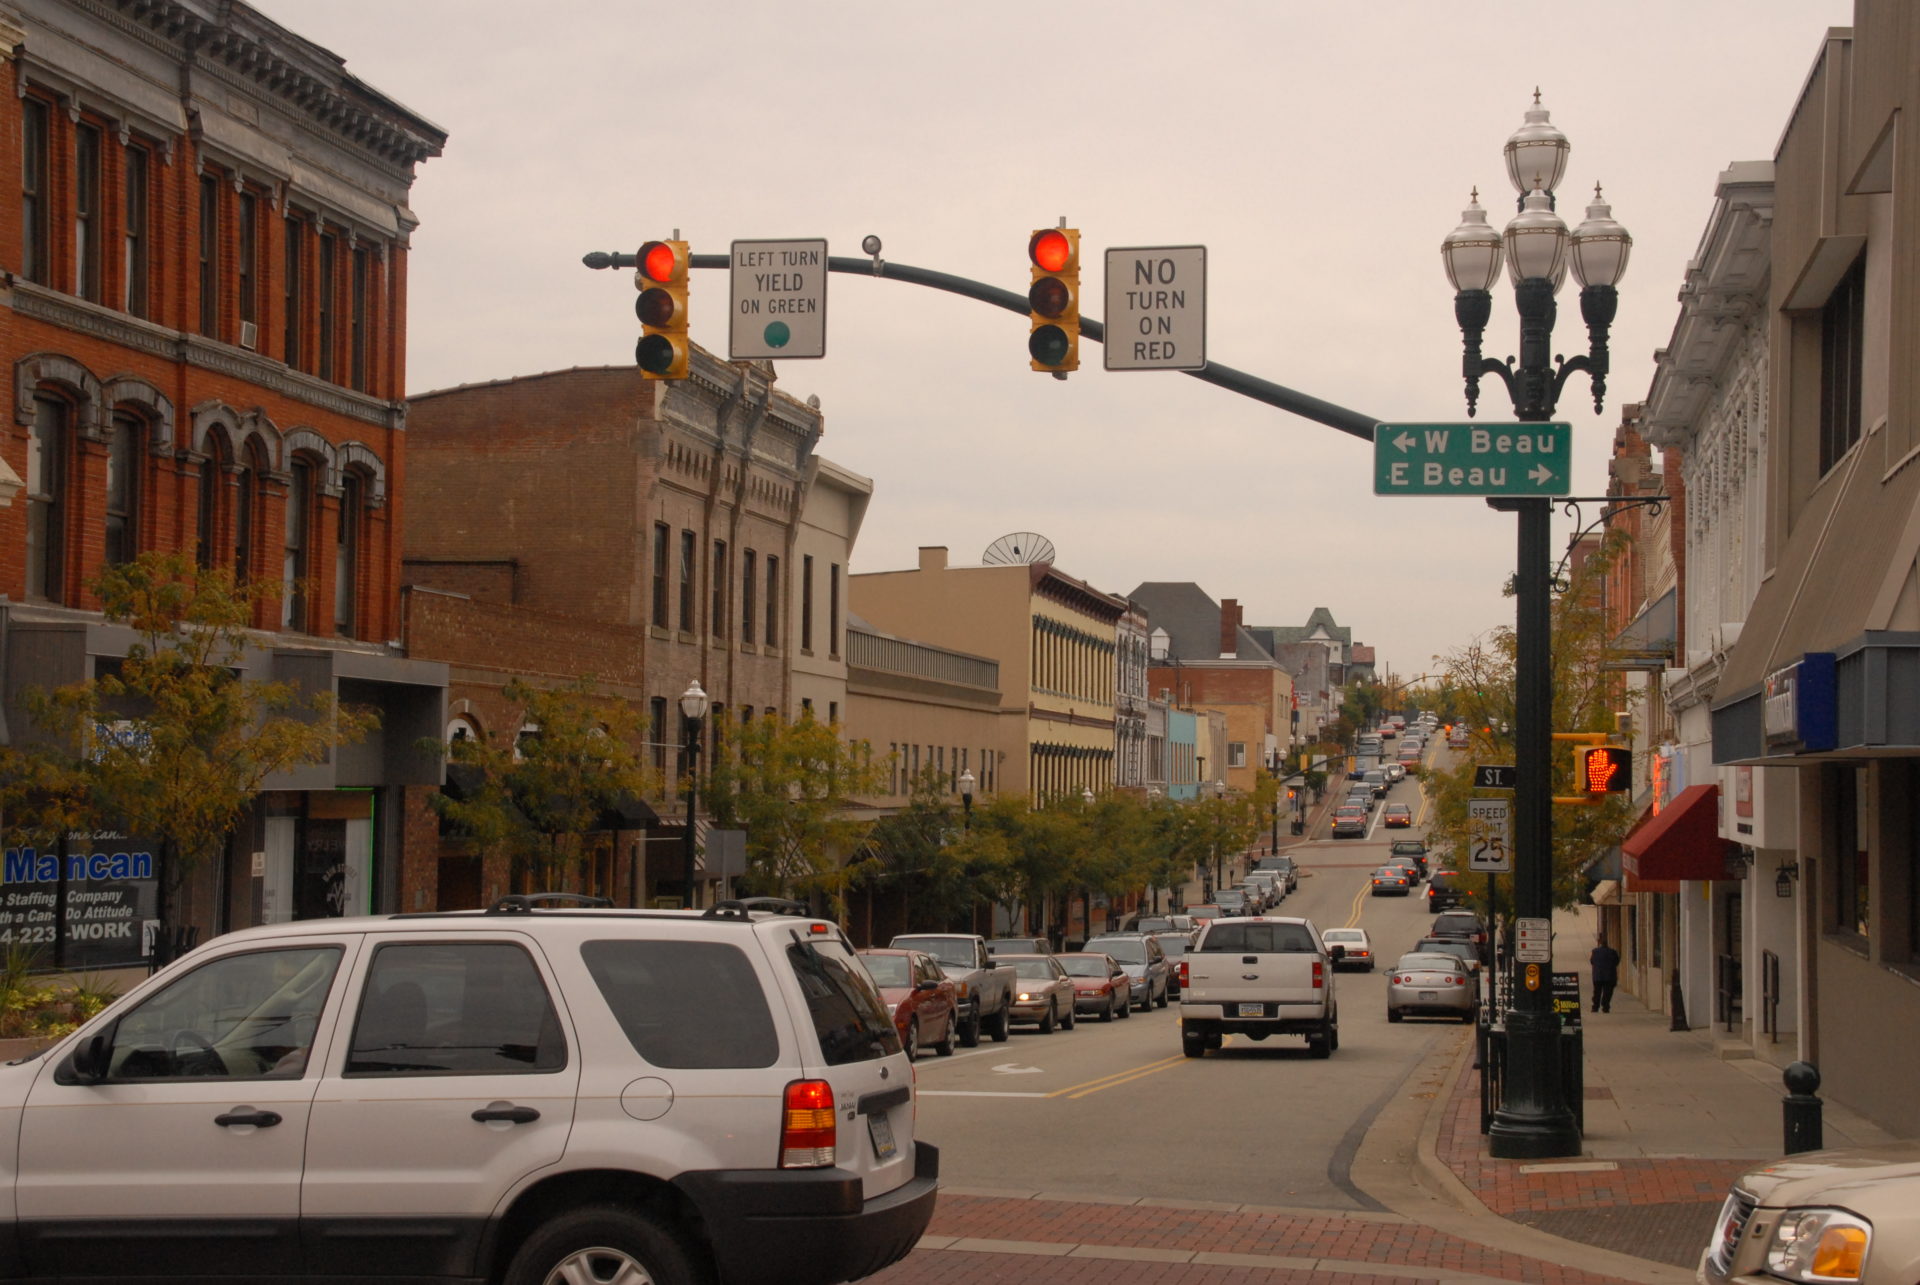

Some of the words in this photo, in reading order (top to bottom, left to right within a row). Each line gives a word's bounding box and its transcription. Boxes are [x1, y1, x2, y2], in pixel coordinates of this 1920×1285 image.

[739, 251, 775, 267] LEFT
[780, 250, 818, 266] TURN
[1135, 258, 1176, 285] NO
[755, 273, 804, 292] YIELD
[740, 299, 760, 314] ON
[768, 298, 816, 314] GREEN
[1126, 290, 1185, 310] TURN
[1139, 316, 1171, 335] ON
[1134, 341, 1176, 361] RED
[1425, 430, 1449, 454] W
[1471, 430, 1554, 454] Beau
[1391, 462, 1409, 486] E
[1424, 462, 1506, 486] Beau
[1485, 768, 1503, 785] ST.
[1472, 807, 1507, 819] SPEED
[1474, 836, 1504, 863] 25
[4, 847, 152, 884] Mancan
[7, 892, 57, 907] Staffing
[66, 890, 123, 904] Company
[15, 913, 24, 923] a
[84, 905, 133, 919] Attitude
